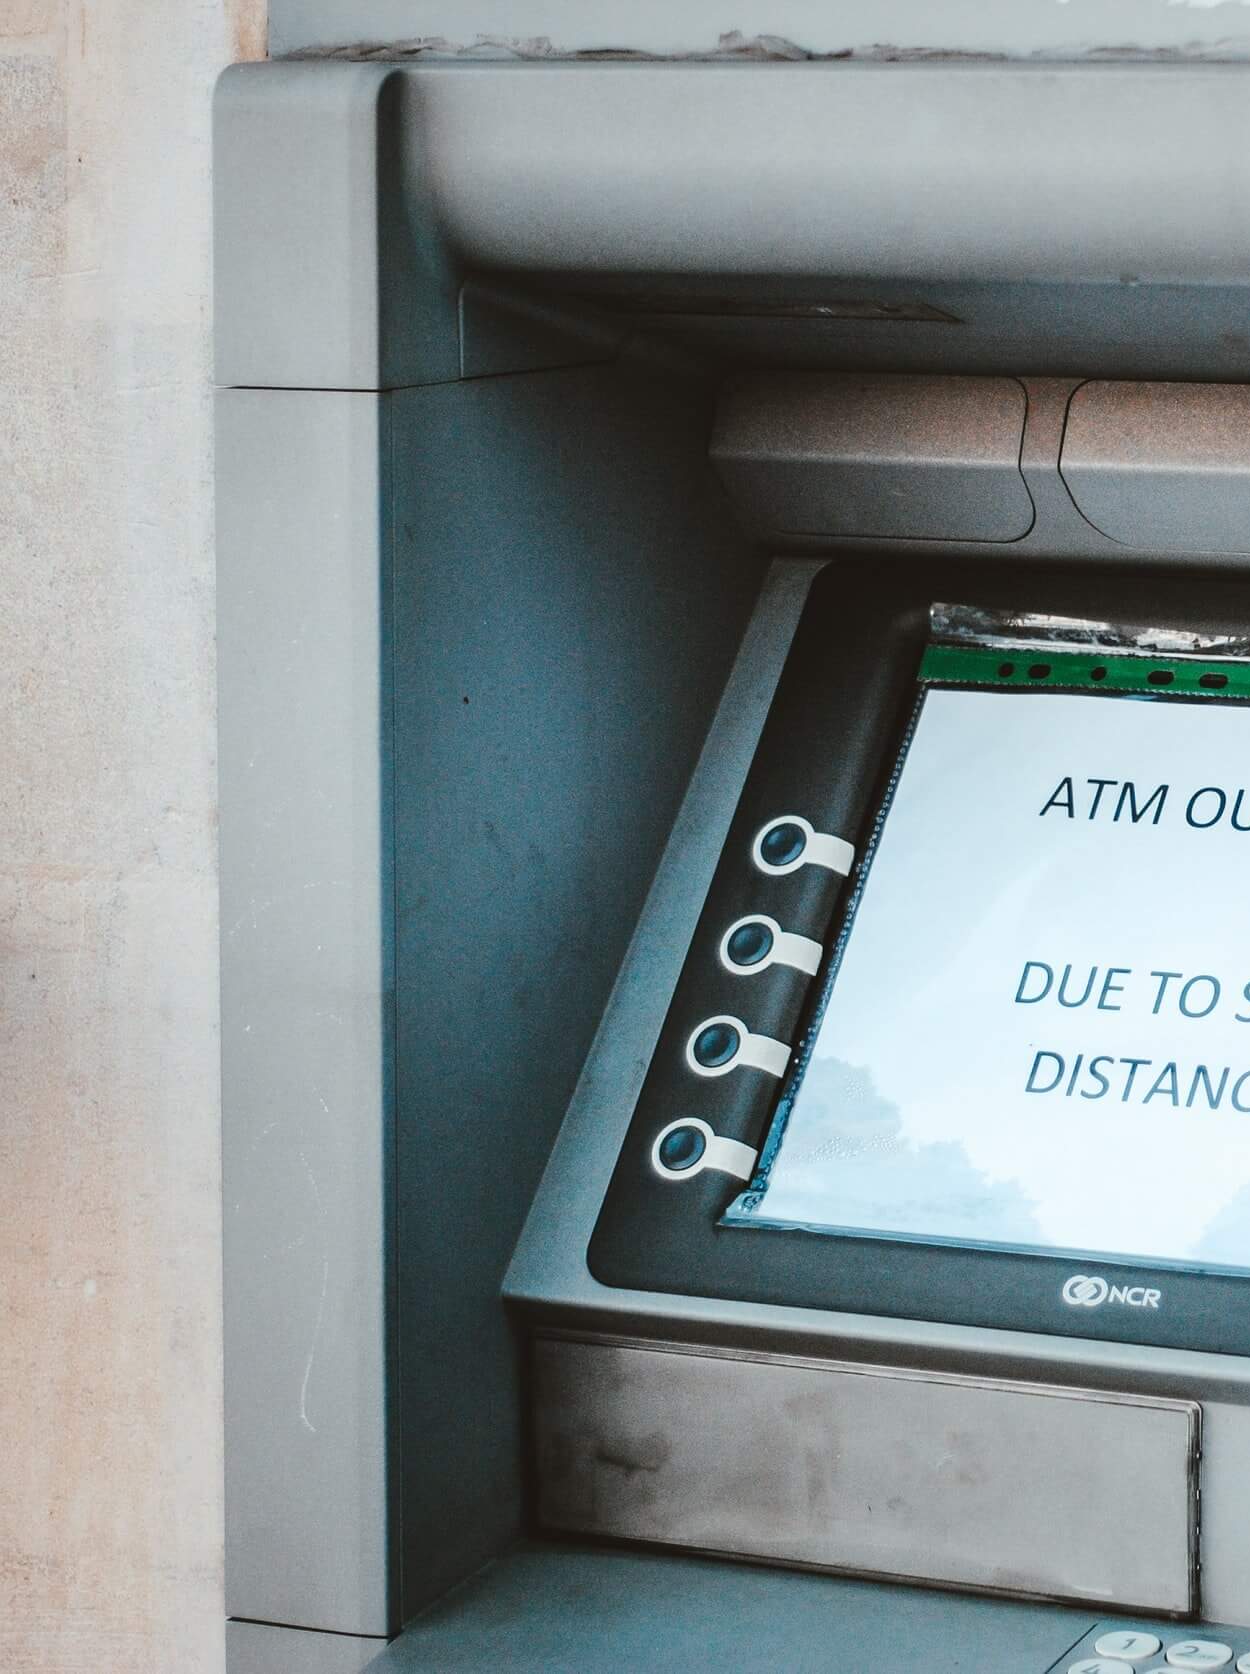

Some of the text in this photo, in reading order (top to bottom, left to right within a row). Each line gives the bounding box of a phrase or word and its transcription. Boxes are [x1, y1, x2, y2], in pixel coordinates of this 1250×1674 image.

[1039, 777, 1170, 825] ATM
[1015, 960, 1133, 1011] DUE
[1150, 970, 1221, 1019] TO
[1108, 1285, 1162, 1308] NCR
[1122, 1638, 1137, 1650] 1
[1175, 1645, 1200, 1657] 2
